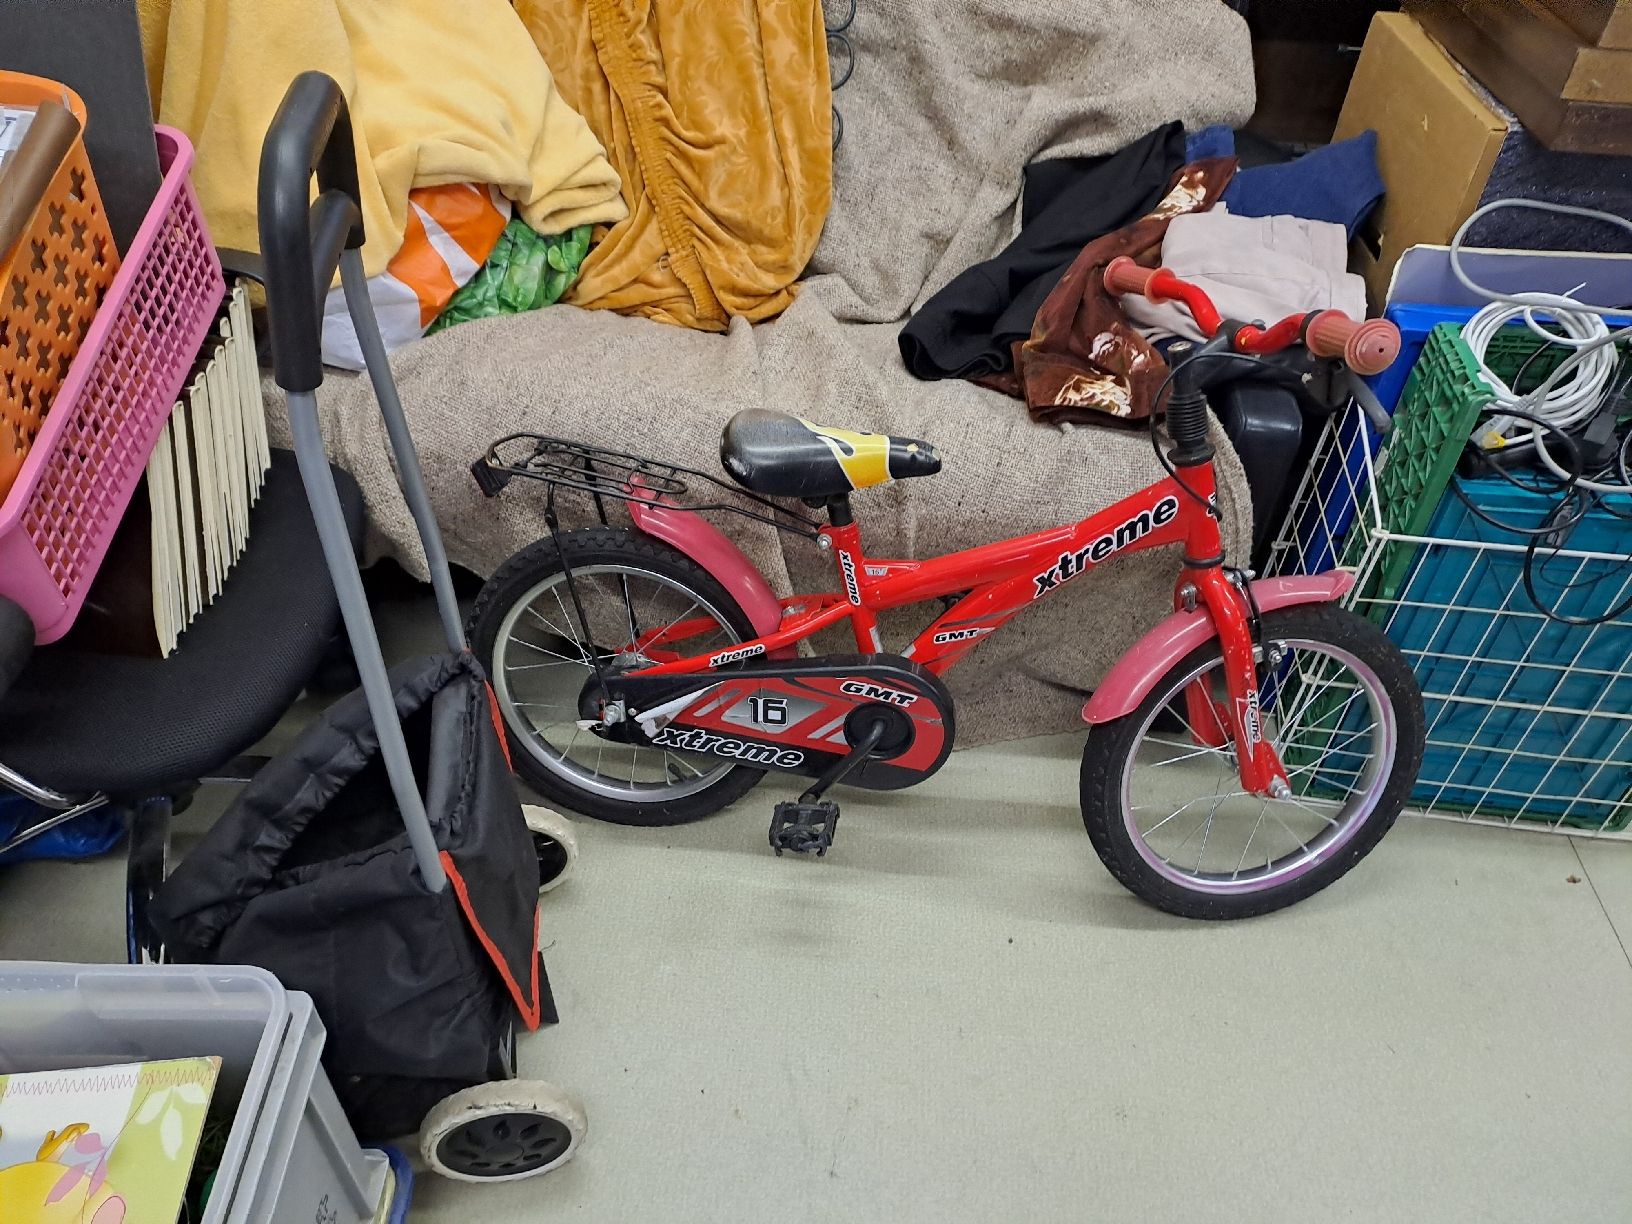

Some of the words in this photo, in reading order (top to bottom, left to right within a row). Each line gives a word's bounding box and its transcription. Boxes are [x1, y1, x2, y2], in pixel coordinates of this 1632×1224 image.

[1034, 496, 1178, 598] xtreme
[839, 550, 861, 605] xtreme
[934, 628, 979, 643] GMT
[709, 644, 765, 667] xtreme
[840, 681, 918, 708] GMT
[748, 696, 789, 726] 16
[652, 728, 804, 767] xtreme
